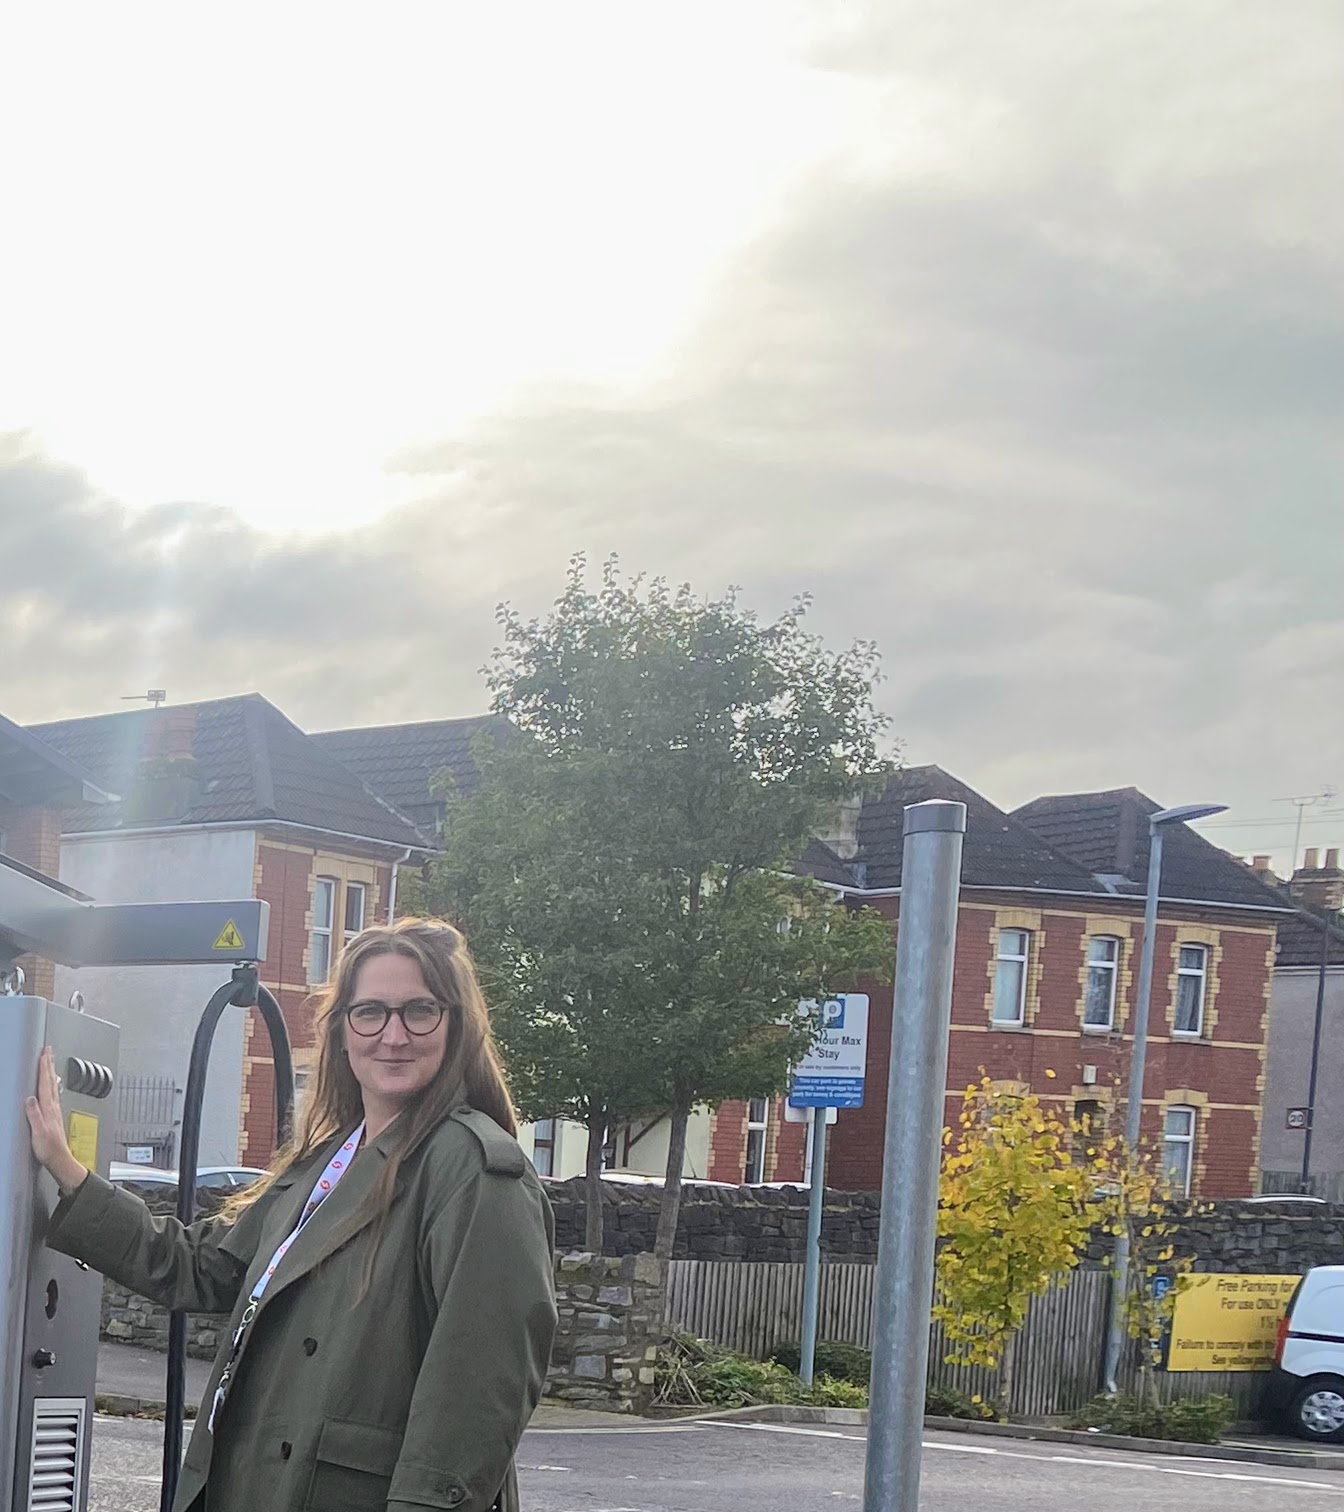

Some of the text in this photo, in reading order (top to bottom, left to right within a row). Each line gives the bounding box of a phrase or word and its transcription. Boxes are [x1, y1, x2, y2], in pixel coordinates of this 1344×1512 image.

[841, 1036, 862, 1045] Max
[818, 1049, 840, 1060] Stay
[1216, 1279, 1238, 1292] Free
[1240, 1279, 1278, 1295] Parking
[1221, 1297, 1237, 1309] For
[1238, 1300, 1254, 1309] use
[1176, 1339, 1204, 1349] Failure
